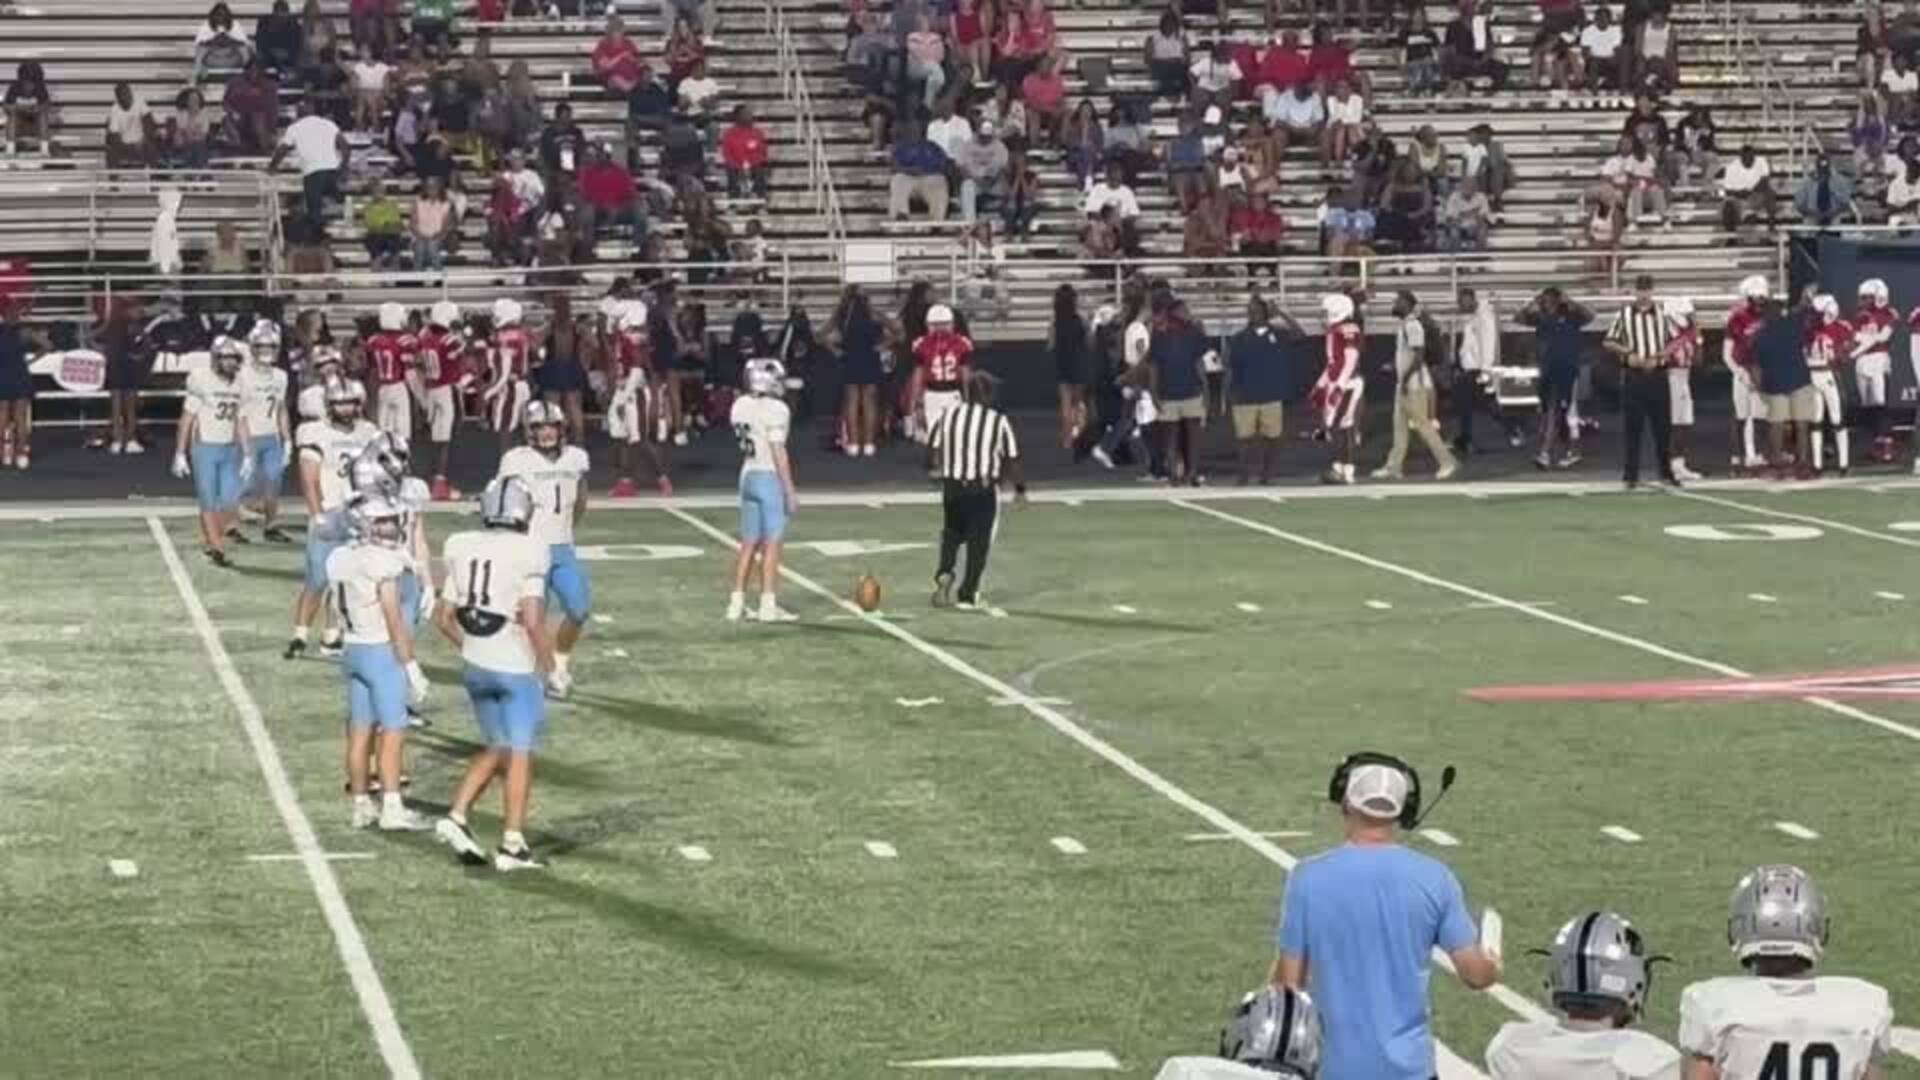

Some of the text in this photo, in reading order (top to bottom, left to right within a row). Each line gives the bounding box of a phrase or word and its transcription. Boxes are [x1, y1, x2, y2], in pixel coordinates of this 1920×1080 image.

[930, 352, 958, 382] 42
[265, 394, 277, 419] 7
[554, 484, 562, 514] 1
[467, 558, 492, 606] 11
